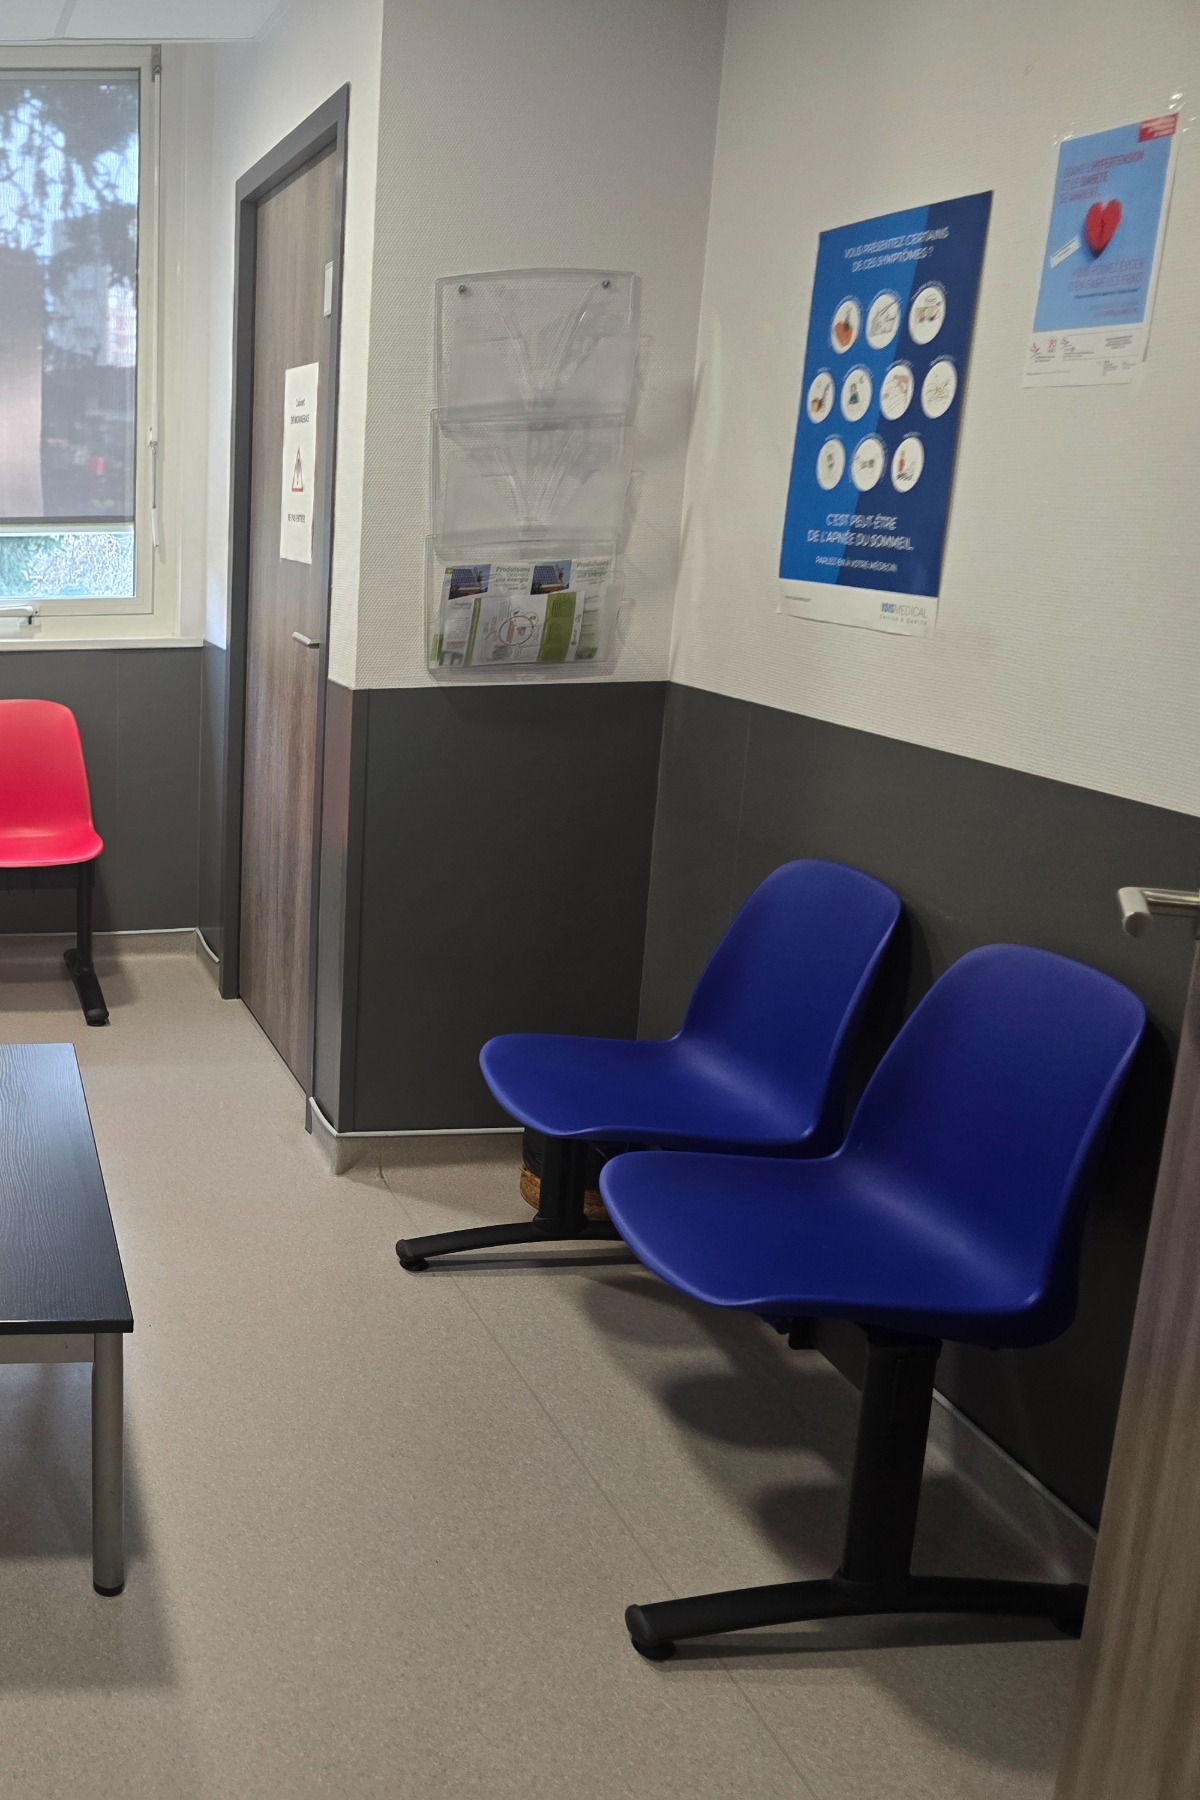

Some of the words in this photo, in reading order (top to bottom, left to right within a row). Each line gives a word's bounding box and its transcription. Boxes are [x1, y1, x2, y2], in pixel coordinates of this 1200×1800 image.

[807, 530, 820, 542] DE
[820, 530, 856, 546] L'APNÉE
[856, 533, 871, 547] DU
